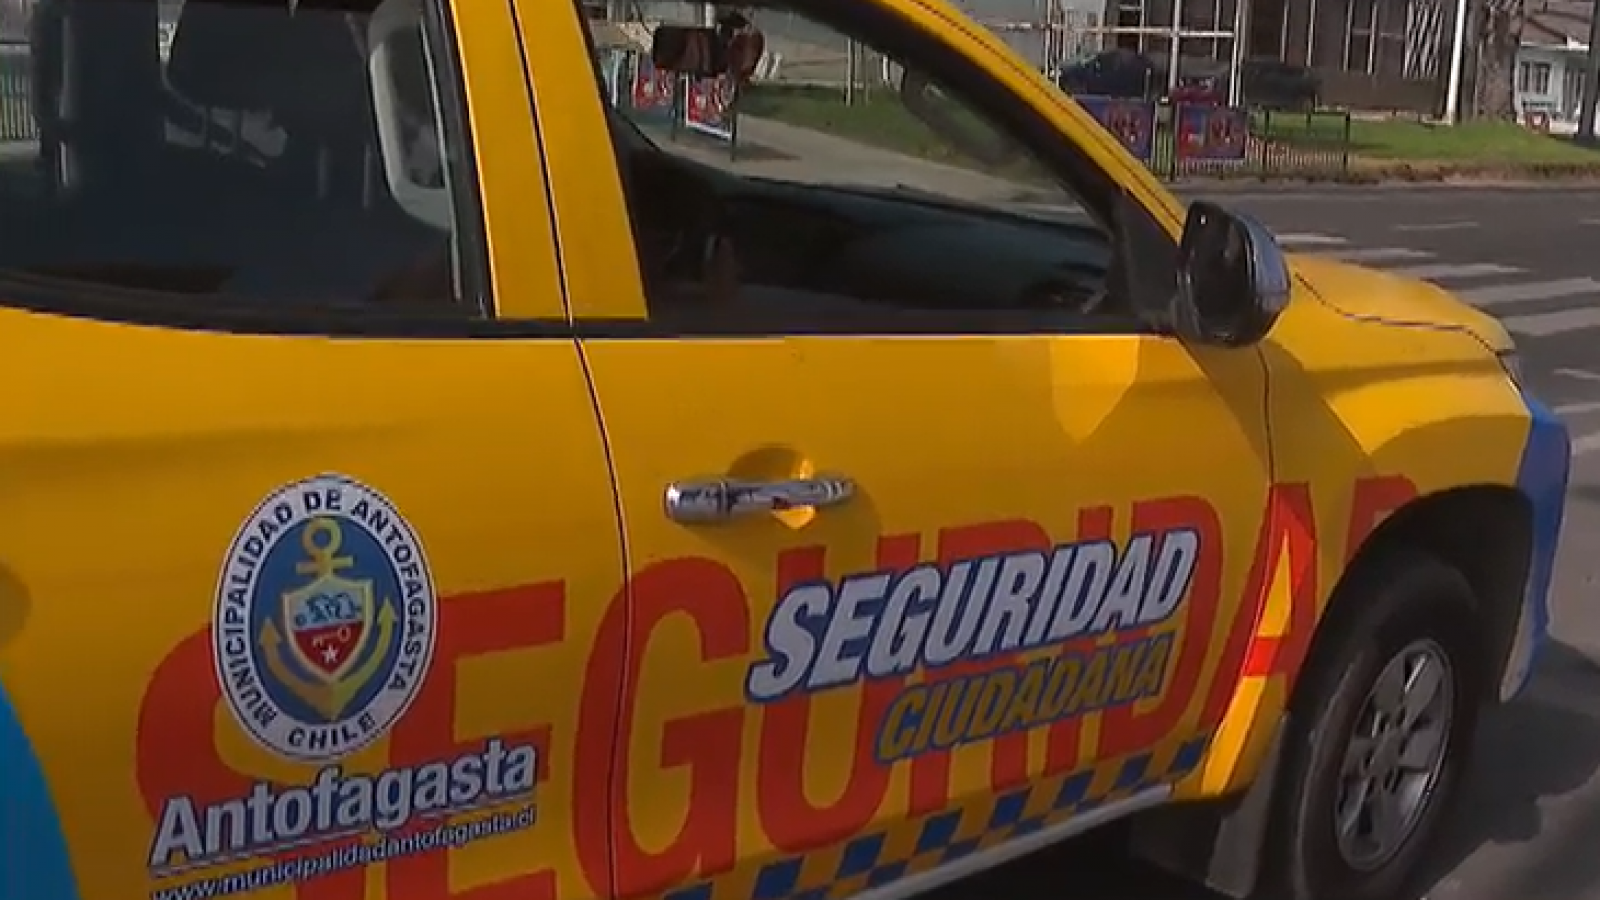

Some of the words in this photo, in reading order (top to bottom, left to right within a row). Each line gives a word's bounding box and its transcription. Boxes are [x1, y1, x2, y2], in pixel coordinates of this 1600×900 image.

[225, 502, 293, 728] MUNICIPALIDAD
[304, 489, 342, 512] DE
[351, 498, 425, 691] ANTOFAGASTA
[746, 527, 1200, 702] SEGURIDAD
[136, 474, 1418, 900] SEGURIDA
[287, 711, 376, 750] CHILE
[875, 630, 1174, 763] CIUDADANA
[149, 737, 537, 868] Antofagasta
